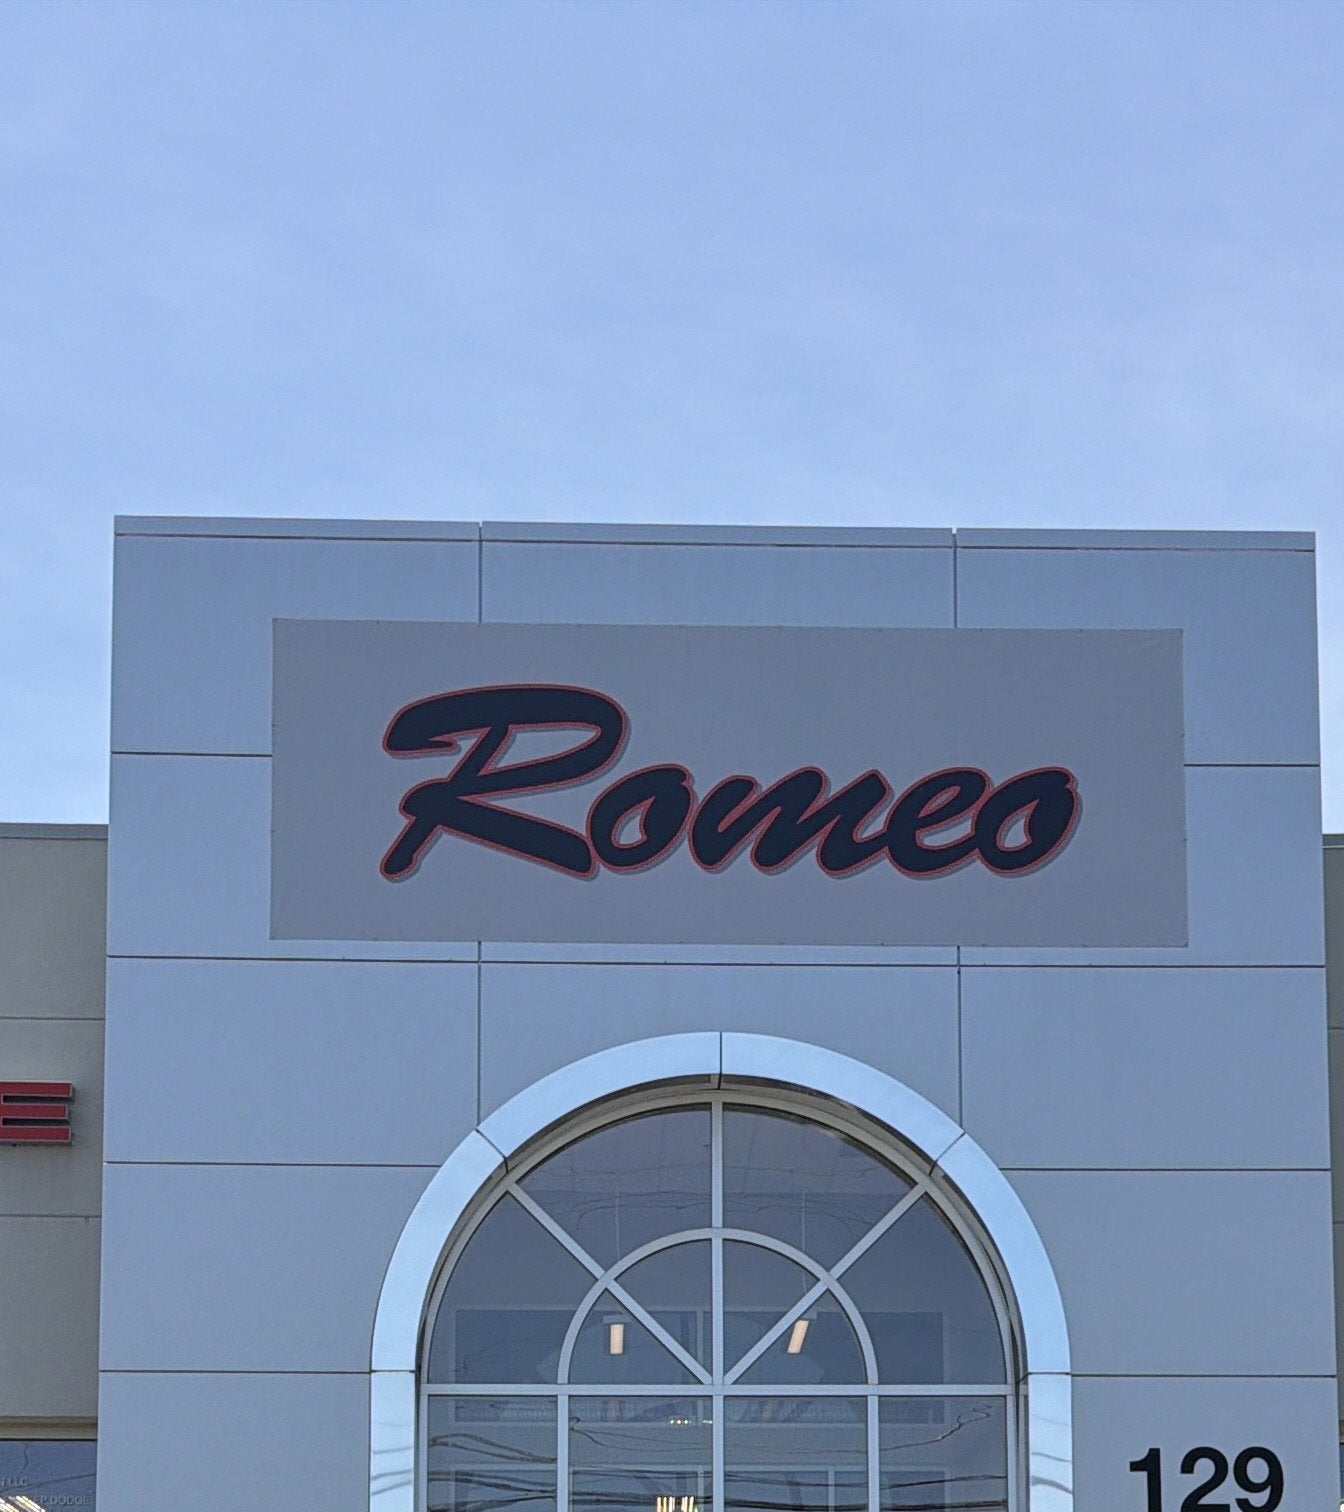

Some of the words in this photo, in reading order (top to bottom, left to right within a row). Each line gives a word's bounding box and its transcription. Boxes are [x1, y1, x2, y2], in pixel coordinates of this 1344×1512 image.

[380, 683, 1082, 881] Romeo
[9, 1476, 28, 1487] LLC
[50, 1495, 90, 1506] DODGE
